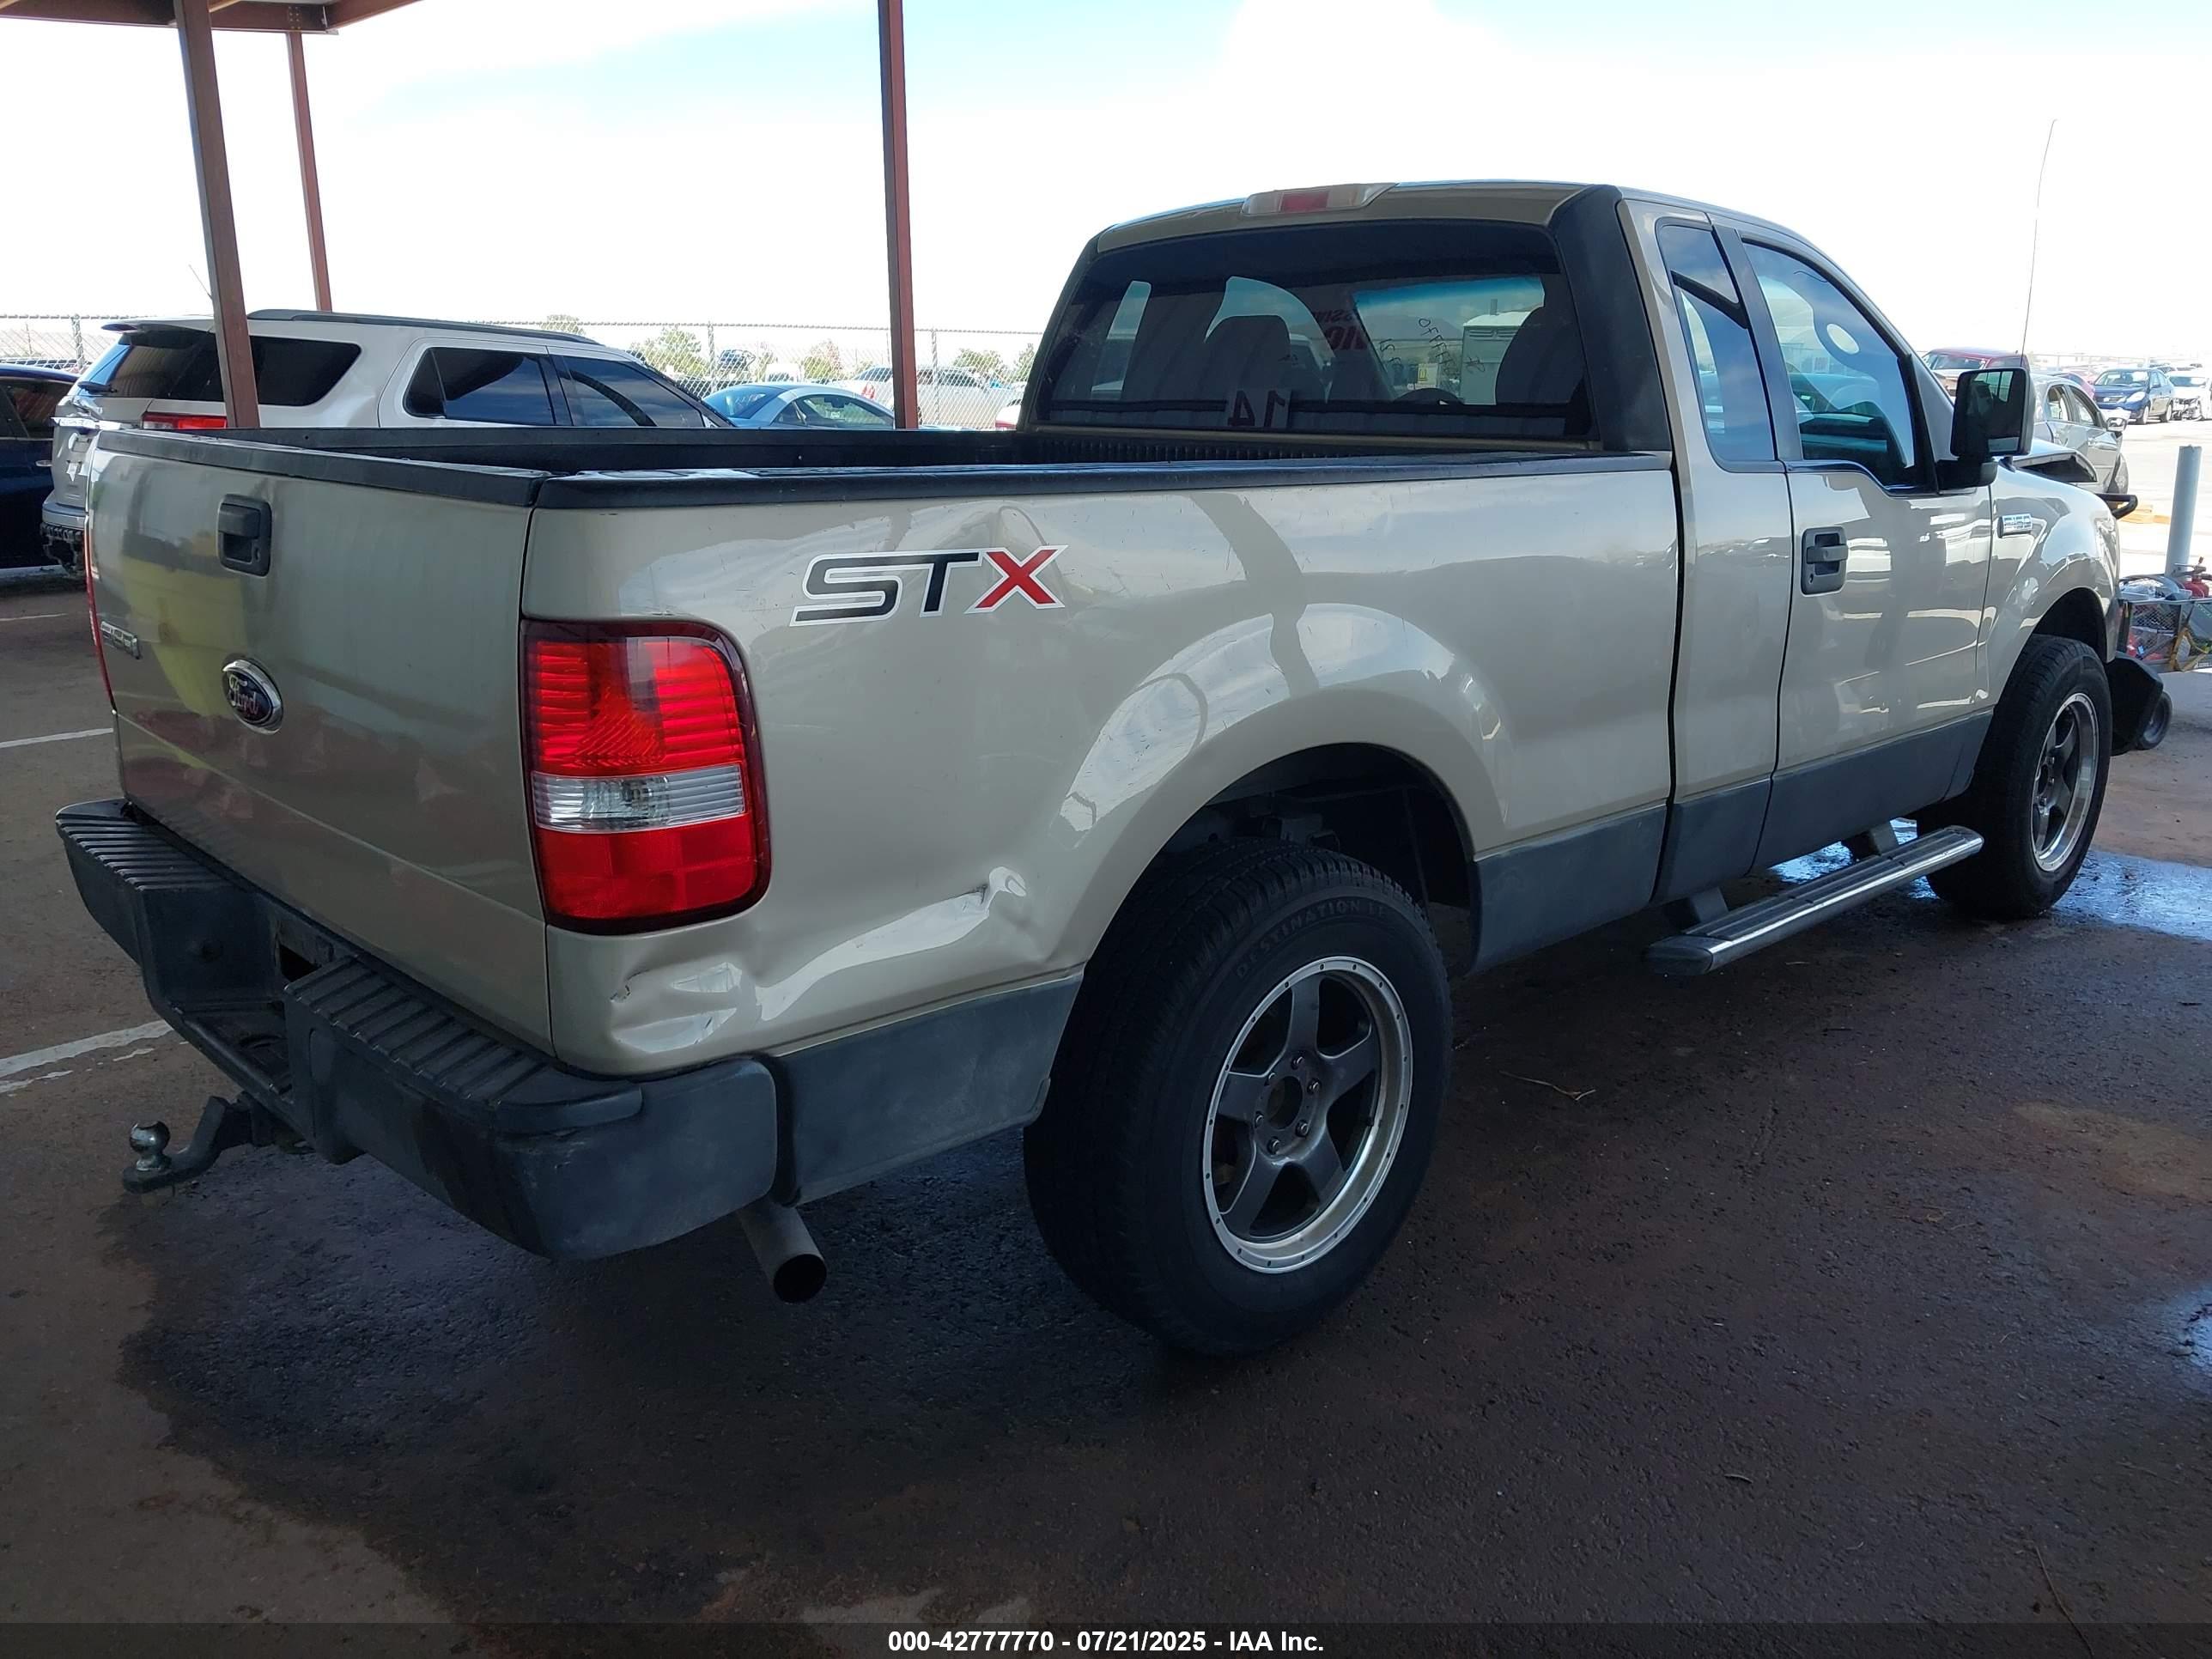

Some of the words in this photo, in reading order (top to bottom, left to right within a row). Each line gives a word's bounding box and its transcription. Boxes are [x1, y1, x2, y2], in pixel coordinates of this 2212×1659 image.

[789, 544, 1069, 627] STX
[228, 673, 260, 714] Ford
[1237, 898, 1362, 979] DESTINATION
